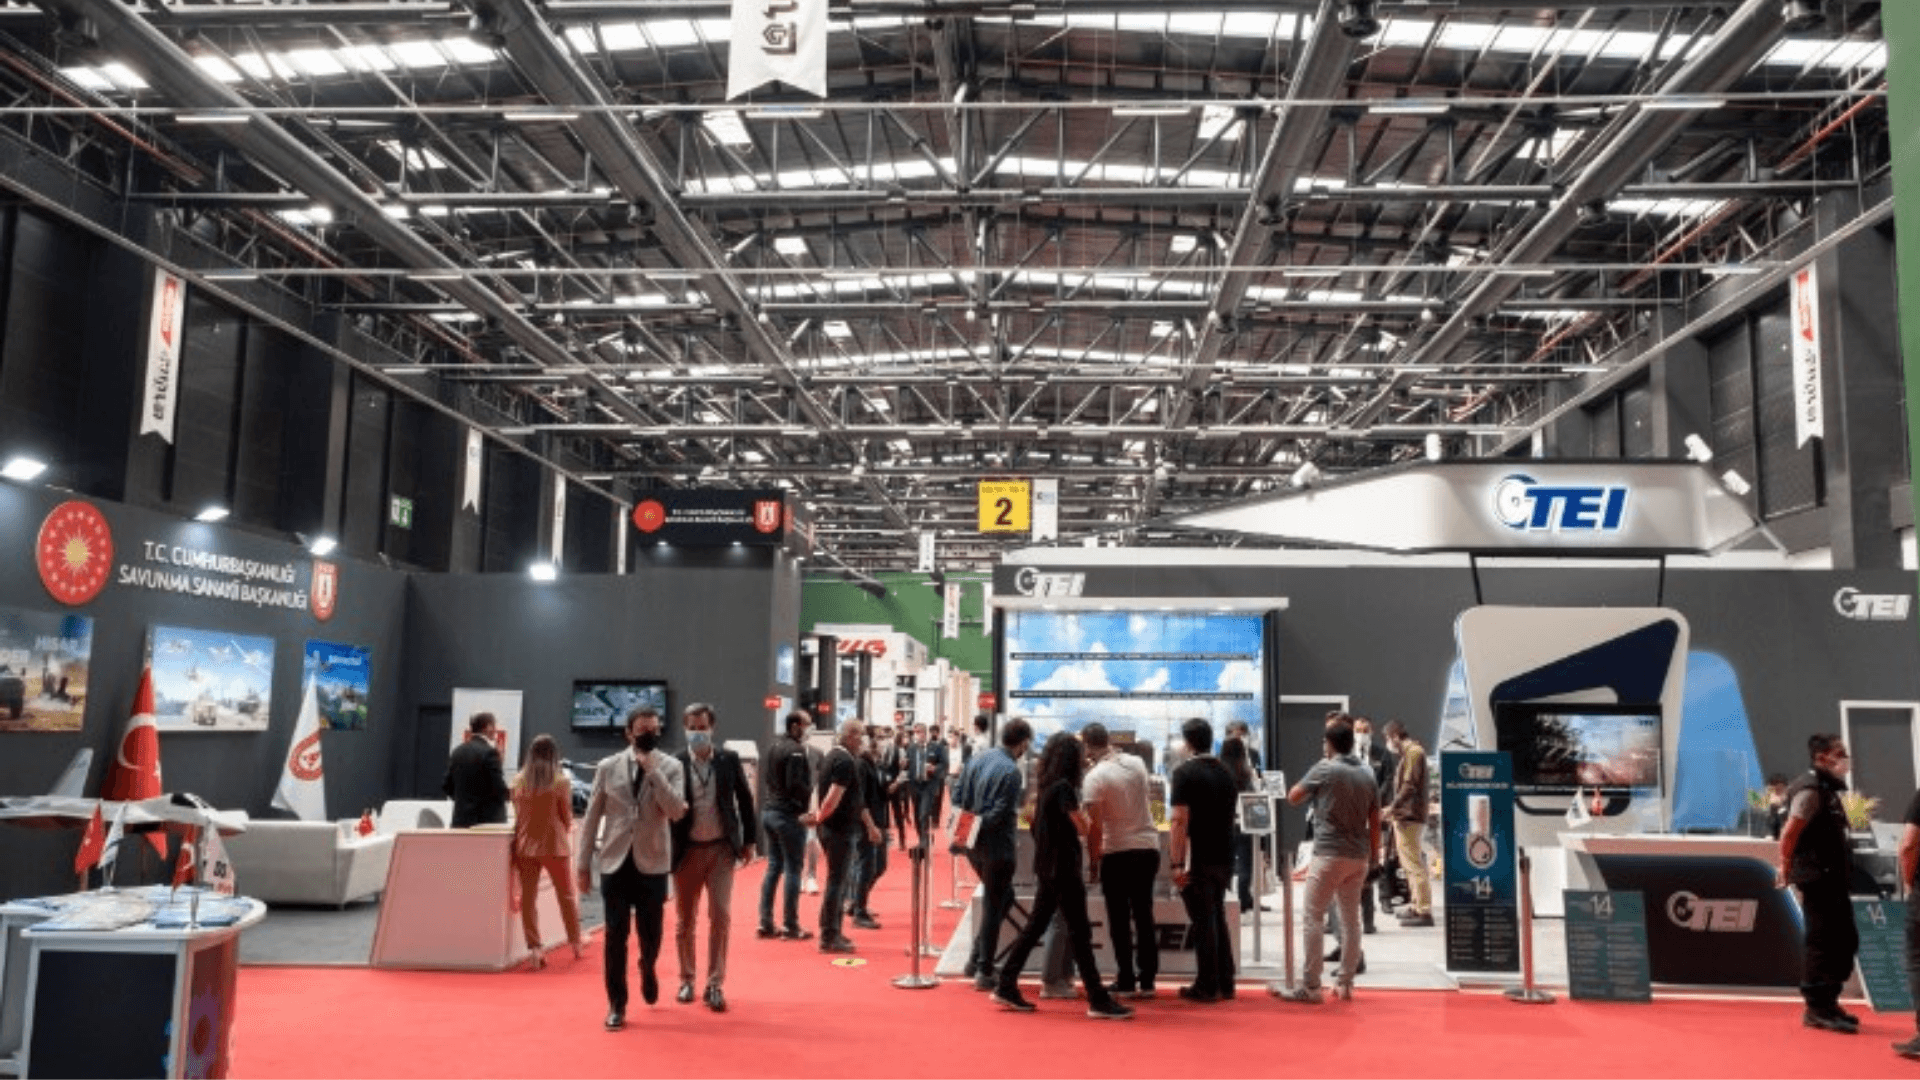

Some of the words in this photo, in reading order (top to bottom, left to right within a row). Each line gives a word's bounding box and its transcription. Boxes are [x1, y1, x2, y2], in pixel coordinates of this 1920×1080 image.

[995, 497, 1013, 525] 2
[1524, 487, 1628, 529] TEI
[144, 541, 169, 563] T.C.
[118, 565, 189, 594] SAVUNMA
[1851, 594, 1912, 621] TEI
[1687, 899, 1759, 932] TEI
